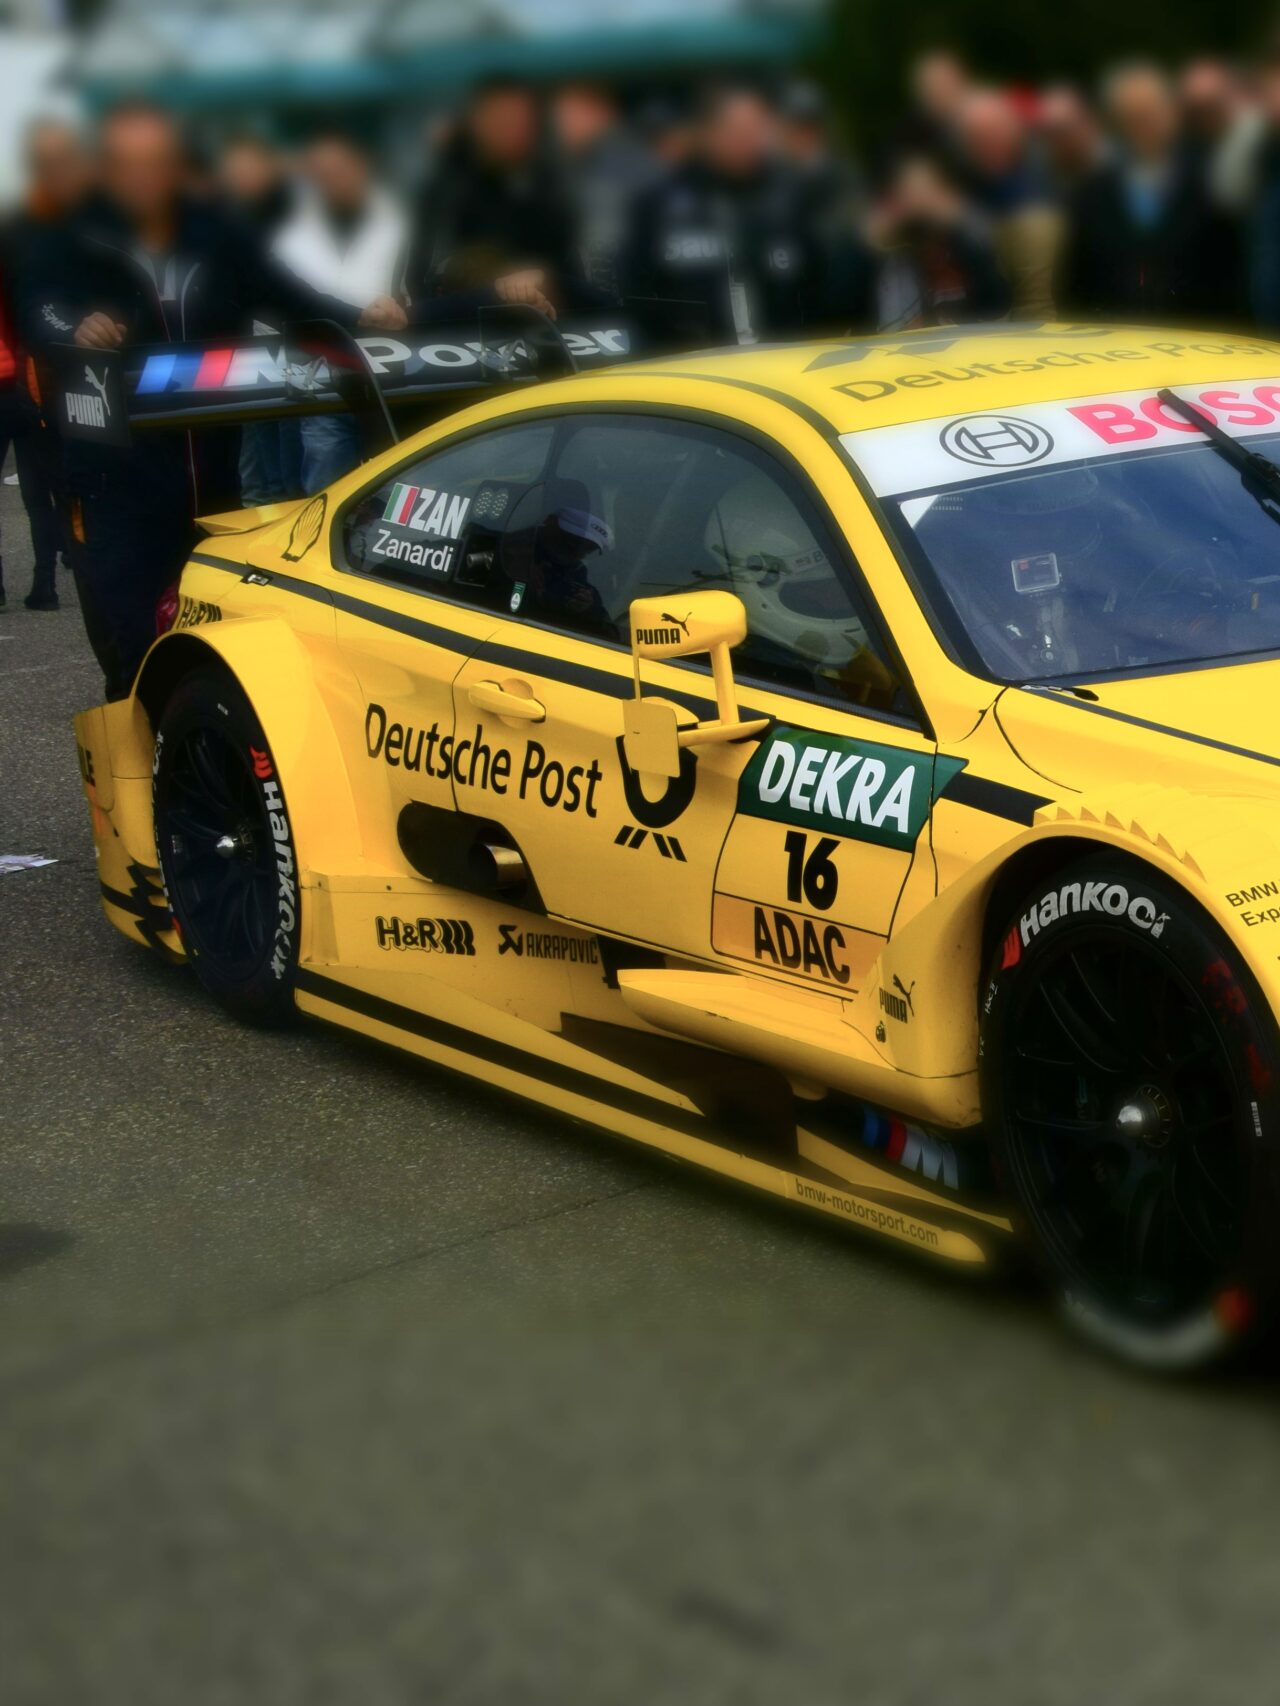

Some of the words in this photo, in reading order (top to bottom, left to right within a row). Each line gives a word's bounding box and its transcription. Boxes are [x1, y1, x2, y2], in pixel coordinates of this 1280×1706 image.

[357, 329, 624, 374] Poer
[831, 344, 1150, 402] Deutsche
[66, 392, 105, 428] PUMA
[409, 488, 470, 540] ZAN
[372, 529, 453, 573] Zanardi
[636, 627, 681, 645] PUMA
[365, 702, 512, 795] Deutsche
[519, 740, 602, 819] Post
[758, 739, 916, 834] DEKRA
[784, 830, 841, 911] 16
[1225, 881, 1280, 908] BMW
[376, 916, 442, 953] H&R
[754, 906, 850, 984] ADAC
[879, 986, 907, 1024] PUMA
[795, 1178, 939, 1246] bmw-motorsport.com
